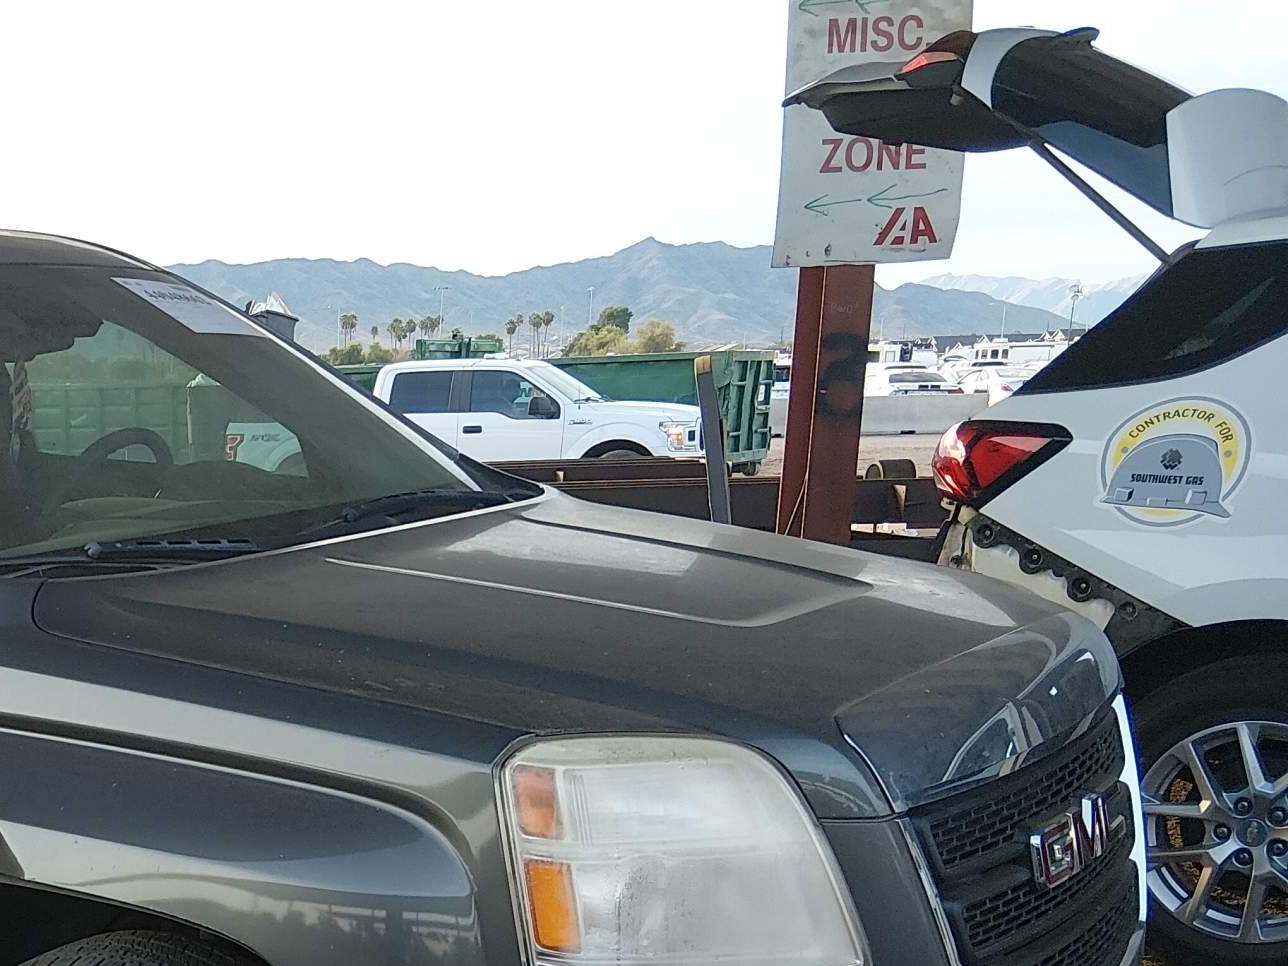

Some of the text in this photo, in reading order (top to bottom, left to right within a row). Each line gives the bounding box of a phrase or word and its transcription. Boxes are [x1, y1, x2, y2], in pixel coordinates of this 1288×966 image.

[819, 137, 927, 173] ZONE
[1128, 408, 1234, 443] CONTRACTOR FOR
[1130, 473, 1205, 485] SOUTHWEST GAS
[1030, 782, 1126, 888] GMC
